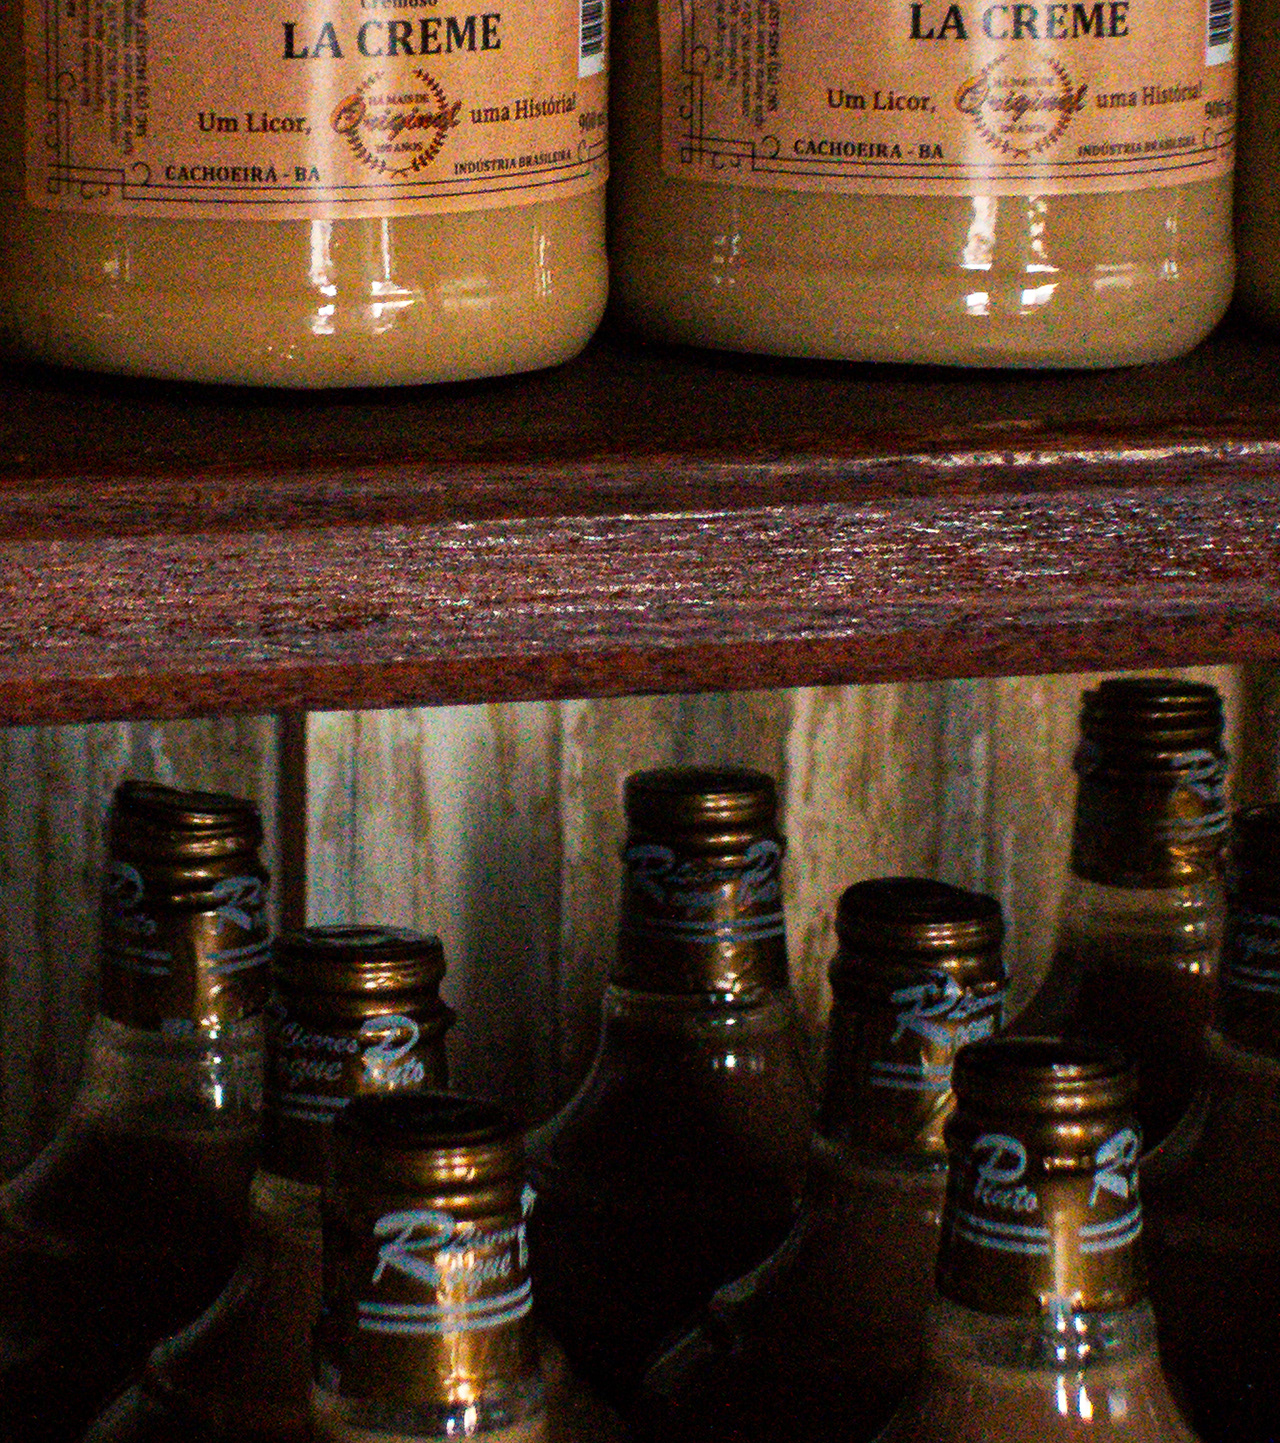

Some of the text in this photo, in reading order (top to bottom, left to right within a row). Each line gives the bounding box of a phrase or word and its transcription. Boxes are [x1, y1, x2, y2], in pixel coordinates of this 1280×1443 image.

[909, 1, 1130, 41] LA CREME
[281, 13, 503, 60] LA CREME
[470, 104, 509, 124] uma
[515, 93, 578, 120] História!
[826, 88, 937, 113] Um Licor,
[954, 77, 1089, 123] Original
[1096, 88, 1135, 109] uma
[197, 111, 312, 138] Um Licor,
[331, 95, 462, 142] Original
[793, 139, 944, 159] CACHOEIRA BA
[164, 164, 320, 183] CACHOEIRA BA
[453, 156, 517, 175] INDÚSTRIA
